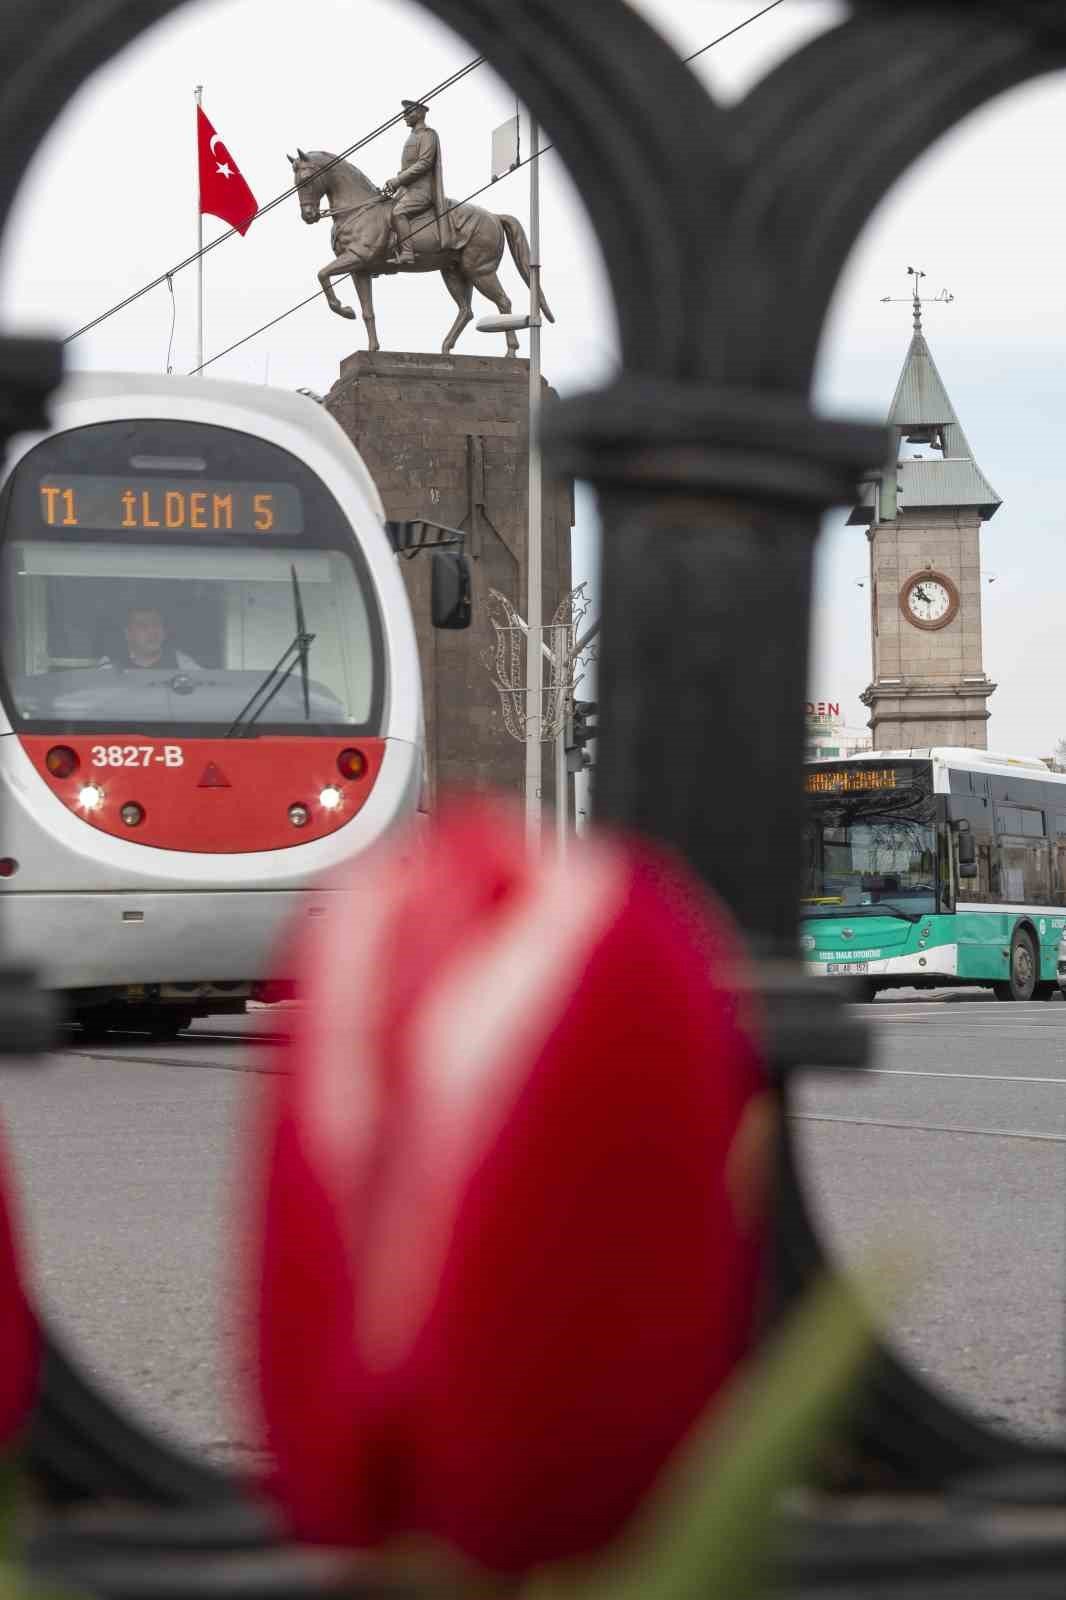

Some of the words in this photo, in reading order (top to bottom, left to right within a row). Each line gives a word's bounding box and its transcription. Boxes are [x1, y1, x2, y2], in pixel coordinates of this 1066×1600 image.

[41, 485, 79, 525] T1
[254, 493, 273, 531] 5
[91, 745, 184, 767] 3827-B
